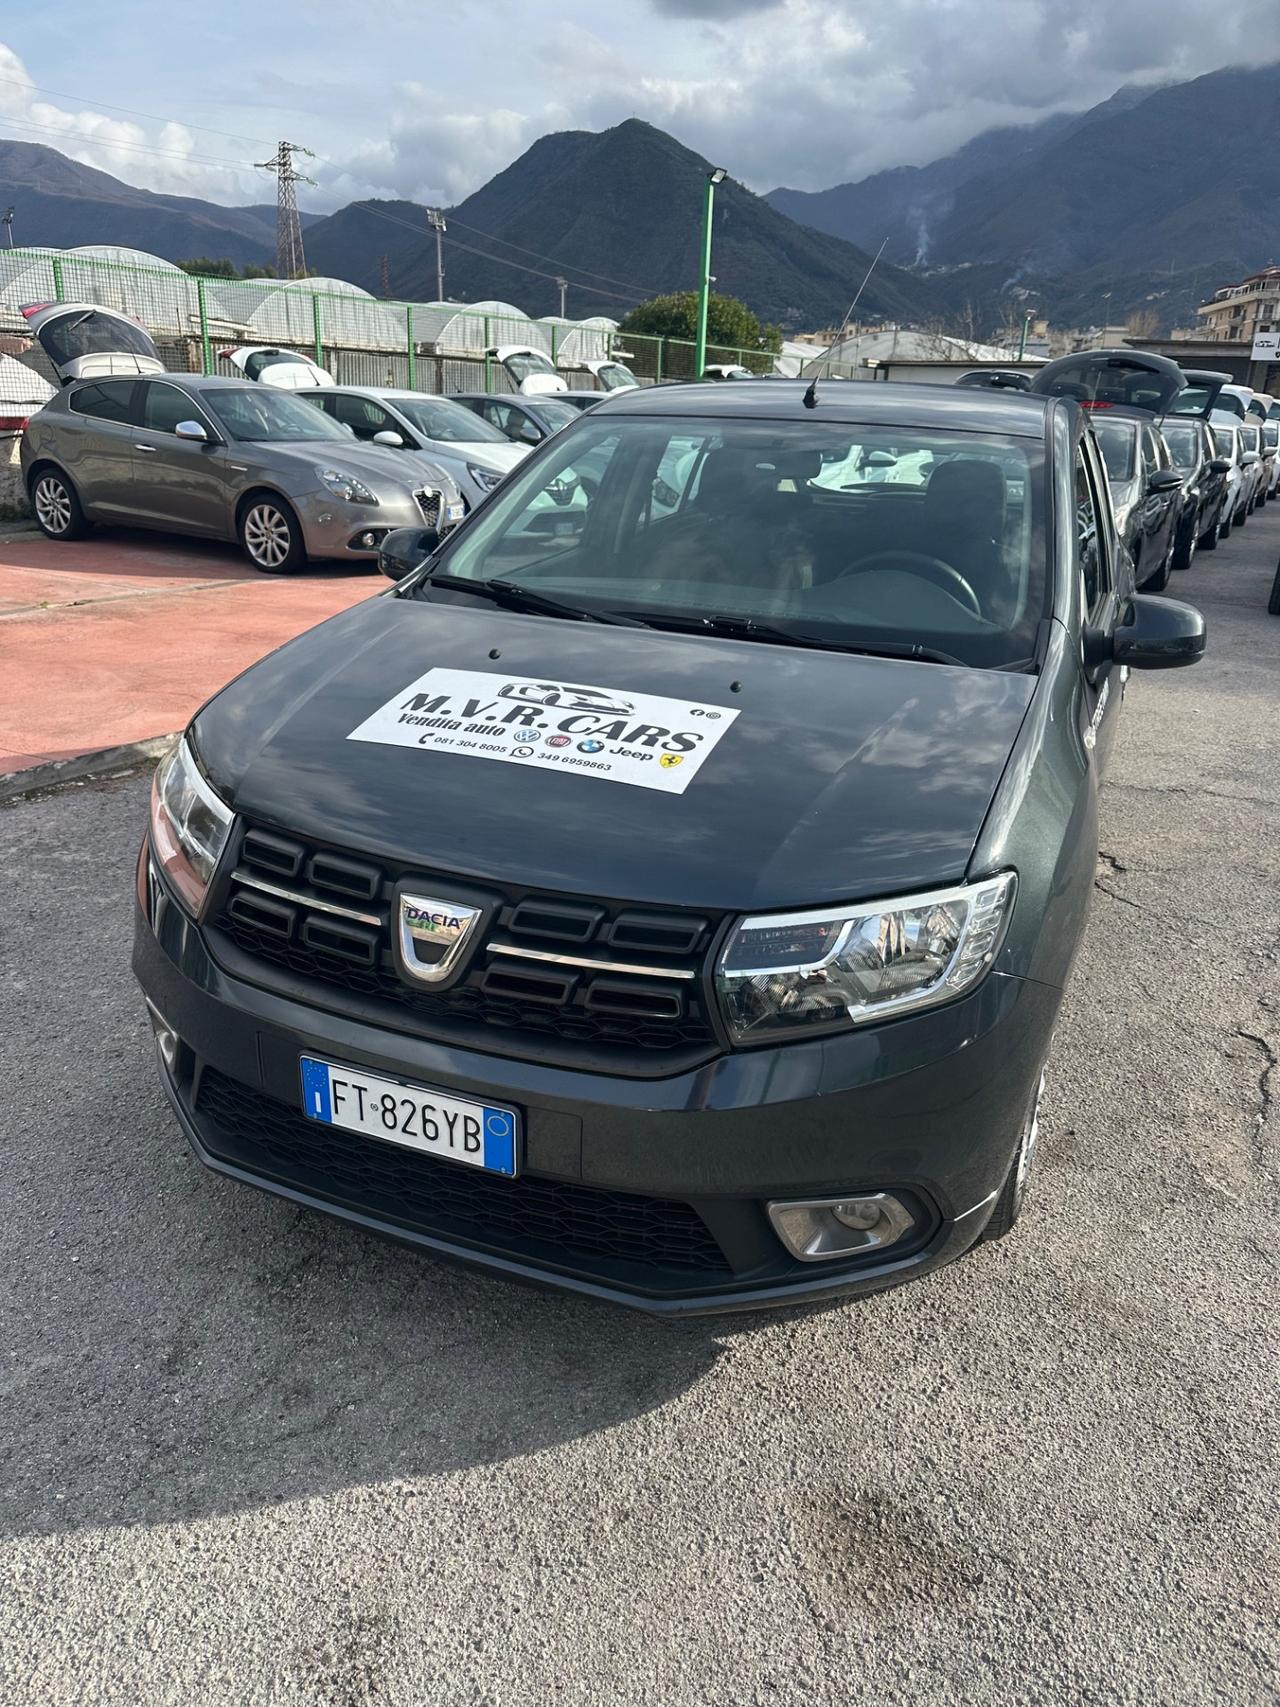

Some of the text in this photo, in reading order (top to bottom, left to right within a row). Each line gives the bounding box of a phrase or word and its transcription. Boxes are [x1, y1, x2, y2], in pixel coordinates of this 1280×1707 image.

[398, 713, 506, 737] Vendita auto
[434, 736, 613, 771] 081 304 8005 349 6959863
[610, 746, 653, 761] Jeep
[407, 907, 461, 930] DACIA
